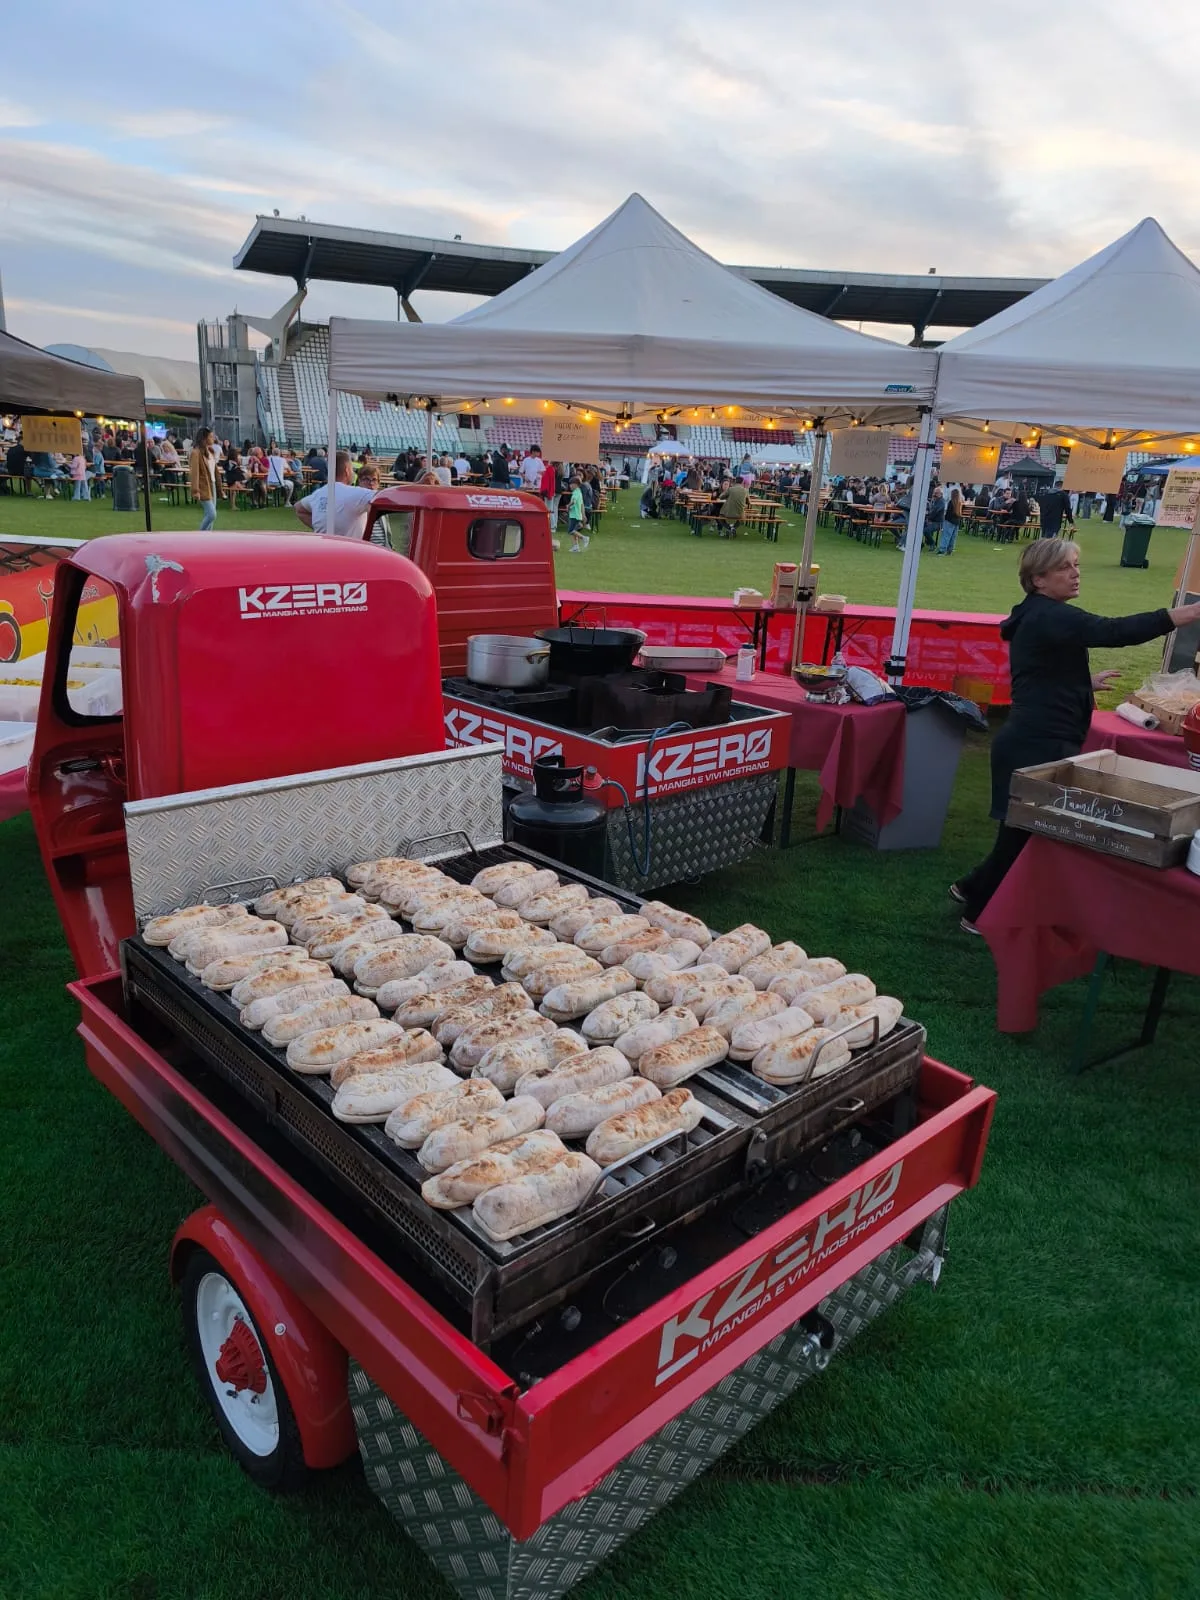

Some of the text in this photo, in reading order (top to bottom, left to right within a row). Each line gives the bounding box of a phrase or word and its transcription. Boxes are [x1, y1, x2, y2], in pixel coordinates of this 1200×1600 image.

[263, 609, 299, 618] MANGIA
[306, 607, 323, 615] VIVI
[323, 605, 368, 614] NOSTRANO
[658, 760, 770, 792] MANGIA E VIVI NOSTRANO
[1053, 785, 1110, 821] Family
[701, 1199, 895, 1353] MANGIA E VIVI NOSTRANO
